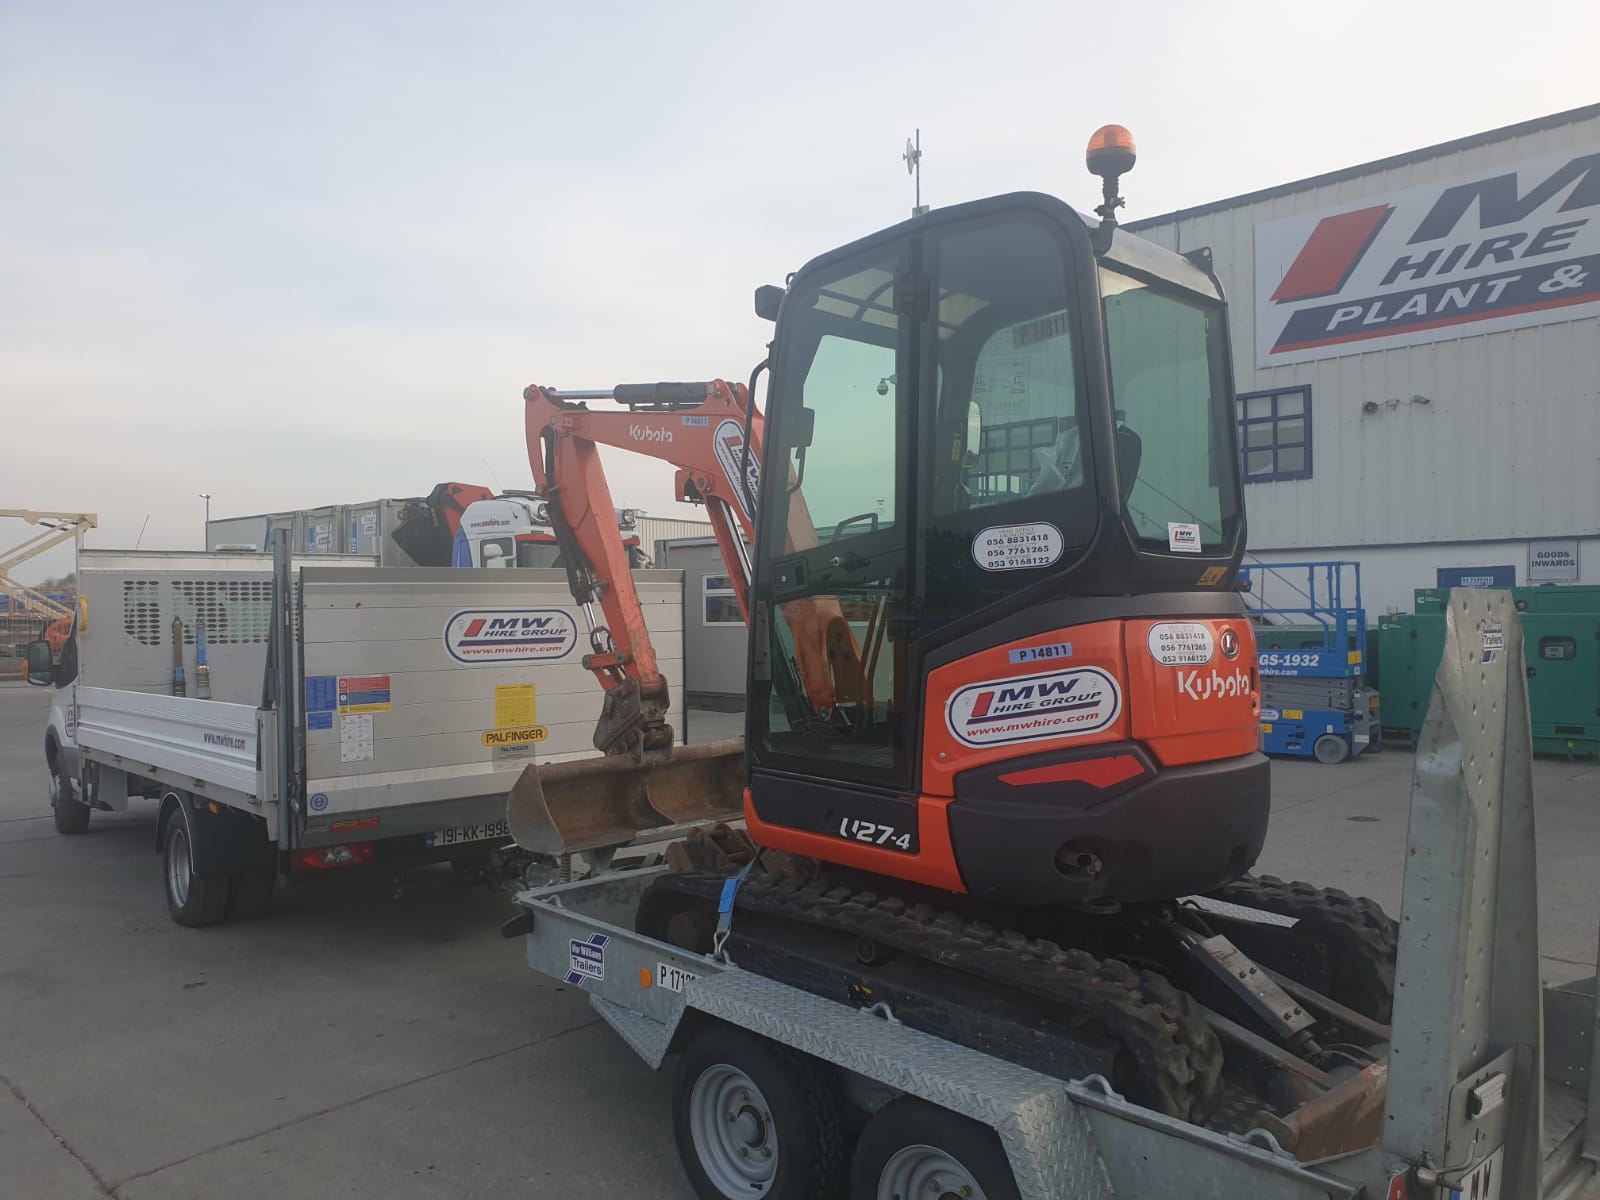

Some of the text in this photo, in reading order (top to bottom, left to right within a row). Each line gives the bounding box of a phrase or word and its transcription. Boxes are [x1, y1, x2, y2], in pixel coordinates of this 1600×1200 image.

[1378, 218, 1591, 287] HIRE
[1325, 264, 1591, 332] PLANT &
[629, 424, 673, 443] Kubota
[986, 538, 1004, 546] 056
[1006, 533, 1049, 544] 8831418
[987, 545, 1049, 557] 056 7761265
[1537, 551, 1570, 559] GOODS
[988, 556, 1050, 568] 053 9168122
[1531, 559, 1576, 568] INWARDS
[489, 617, 553, 630] MW
[521, 628, 567, 636] GROUP
[1160, 633, 1174, 641] 056
[462, 646, 562, 655] www.mwhire.com
[1019, 645, 1068, 661] P 14811
[1161, 643, 1207, 652] 056 7761265
[1258, 653, 1320, 667] GS-1932
[997, 678, 1080, 703] MW
[1177, 667, 1250, 701] Kubota
[993, 691, 1103, 714] HIRE GROUP
[966, 712, 1100, 737] www.mwhire.com
[486, 728, 544, 744] PALFINGER
[839, 817, 911, 850] U27-4
[572, 956, 603, 976] Trailers
[660, 965, 667, 985] P
